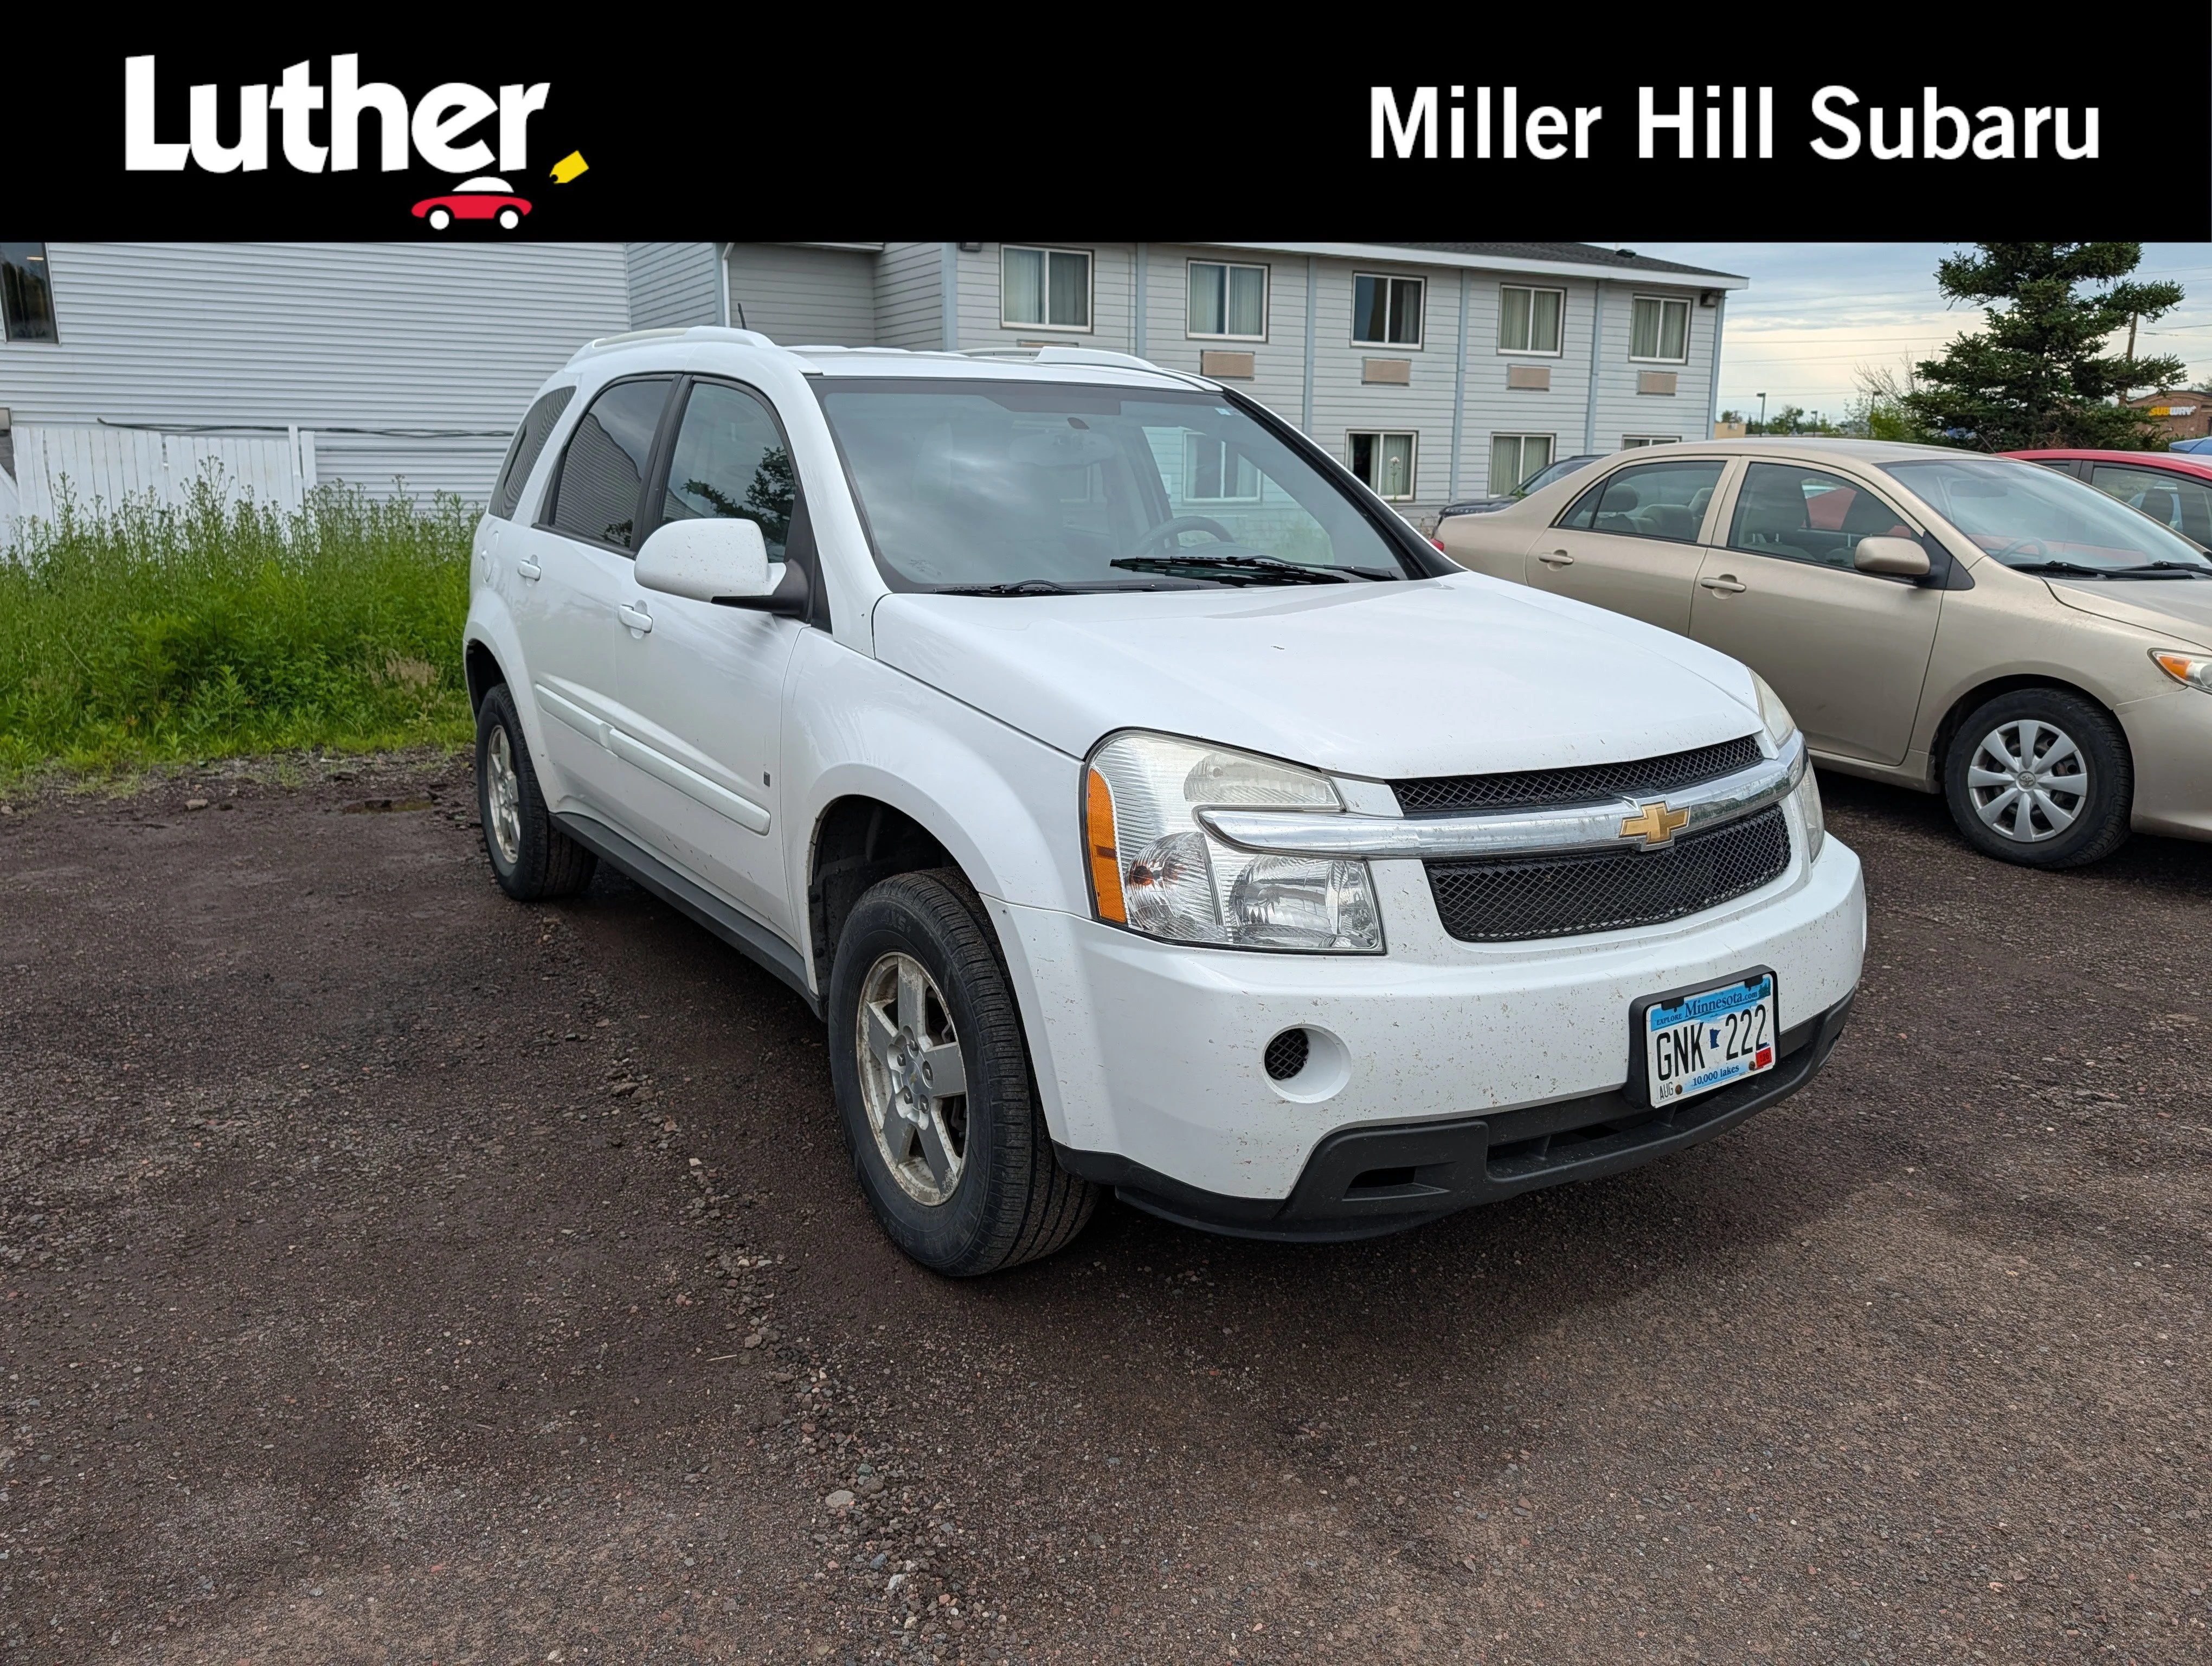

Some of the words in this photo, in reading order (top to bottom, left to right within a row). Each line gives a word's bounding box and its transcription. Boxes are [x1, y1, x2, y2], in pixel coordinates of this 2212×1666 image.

[2149, 406, 2196, 416] SUBWAY
[1656, 1013, 1682, 1026] EXPLORE
[1656, 1022, 1706, 1081] GNK
[1725, 1004, 1767, 1061] 222
[1693, 1071, 1718, 1086] 10,000
[1720, 1065, 1739, 1078] lakes
[1660, 1081, 1674, 1100] AUG
